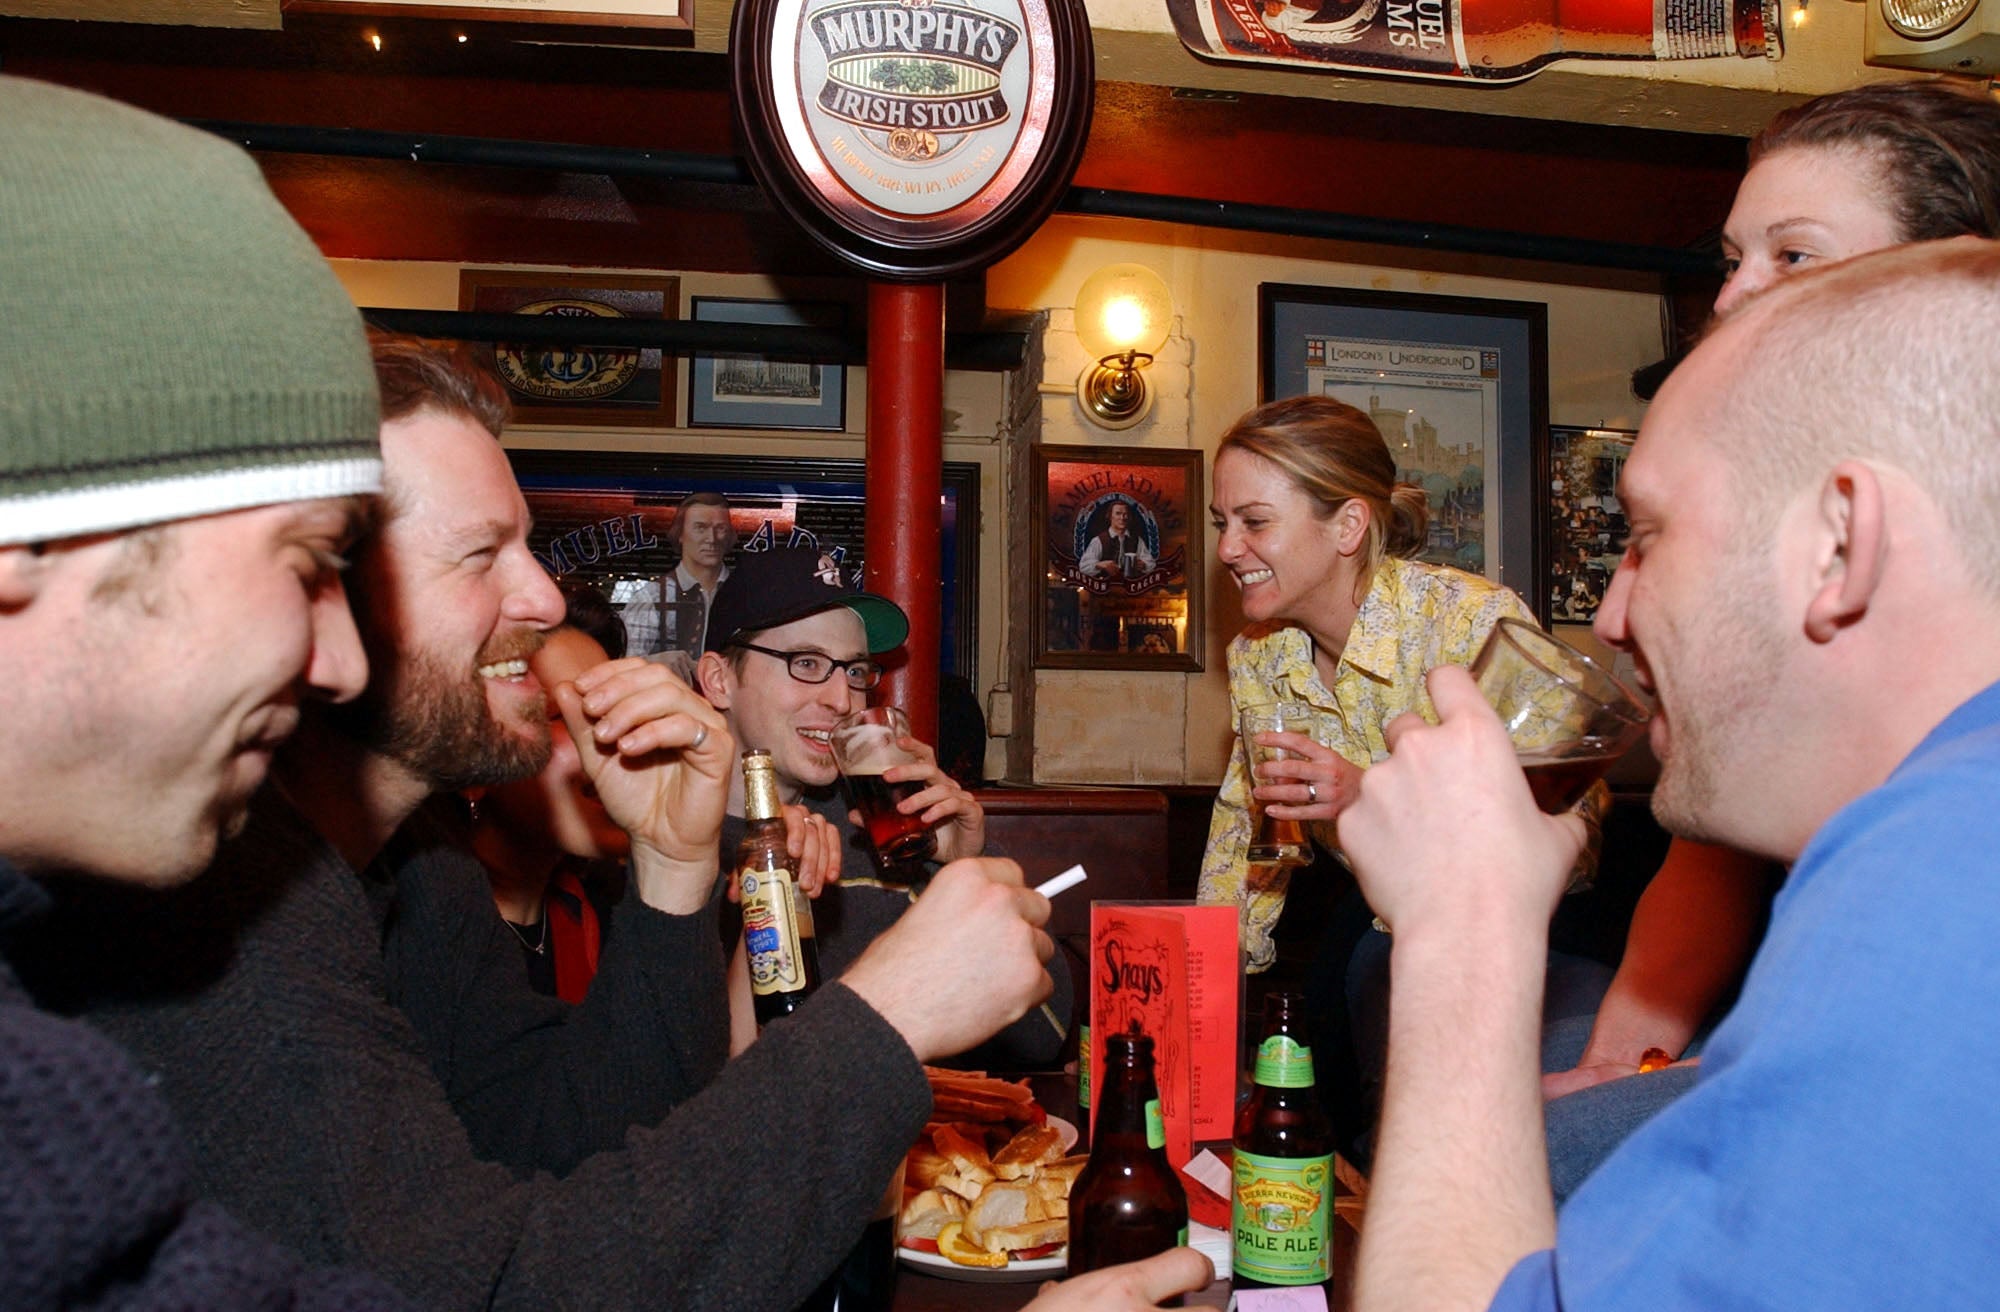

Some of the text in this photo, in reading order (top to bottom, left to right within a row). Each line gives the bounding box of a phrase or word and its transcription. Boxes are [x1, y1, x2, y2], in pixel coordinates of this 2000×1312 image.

[821, 9, 1005, 63] MURPHY'S
[1231, 0, 1265, 40] AGER
[833, 87, 997, 127] IRISH STOUT
[1389, 351, 1475, 371] UNDERGROUND
[1101, 939, 1164, 1006] Shays
[1237, 1228, 1320, 1253] PALE ALE
